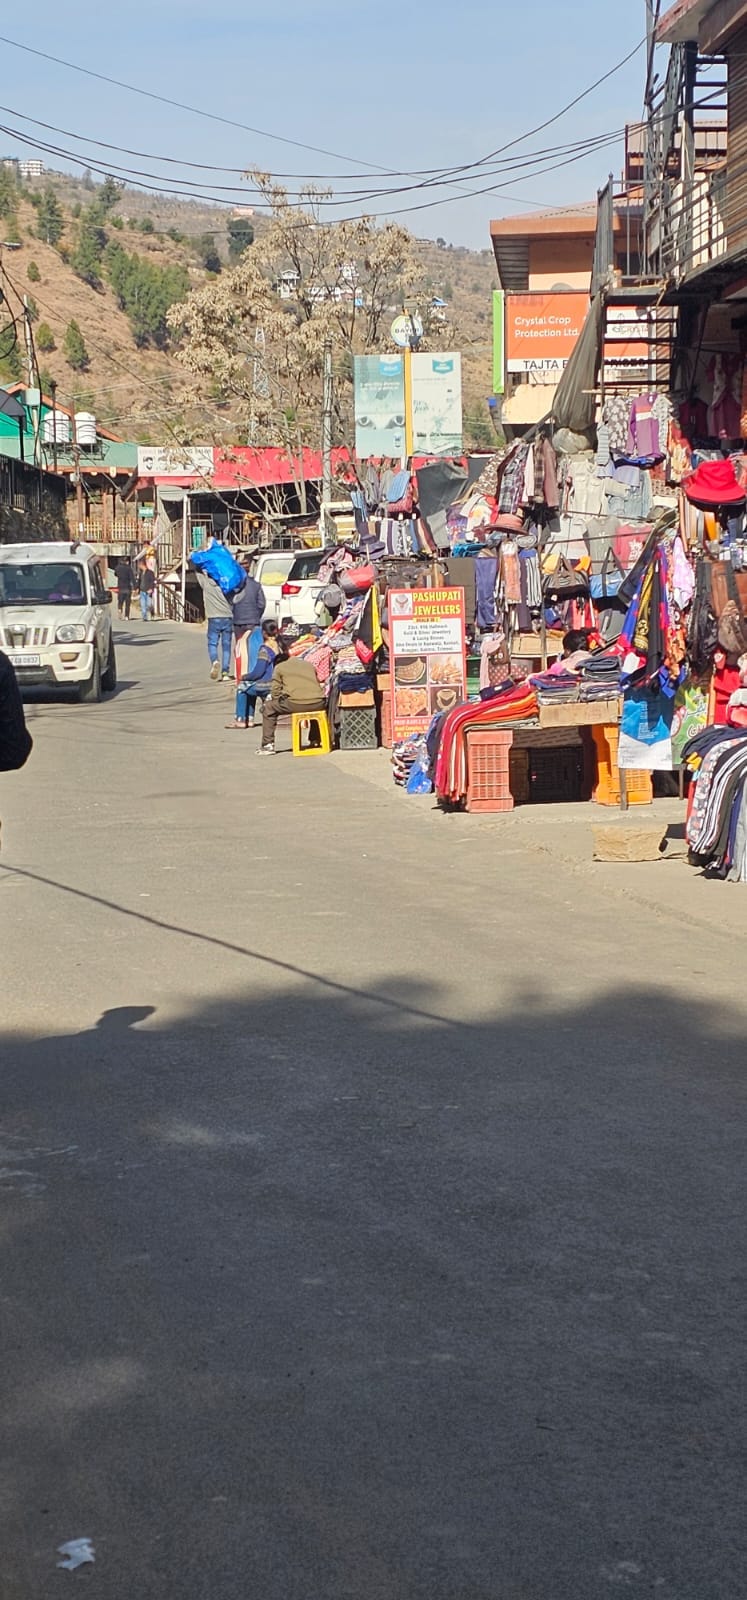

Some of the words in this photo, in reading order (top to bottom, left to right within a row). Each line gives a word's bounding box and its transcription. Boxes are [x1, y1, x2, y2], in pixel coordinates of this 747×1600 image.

[514, 316, 547, 326] Crystal
[548, 315, 571, 325] Crop
[514, 328, 561, 338] Protection
[563, 328, 580, 336] Ltd.
[523, 360, 559, 369] TAJTA
[413, 591, 460, 602] PASHUPATI
[414, 604, 461, 615] JEWELLERS
